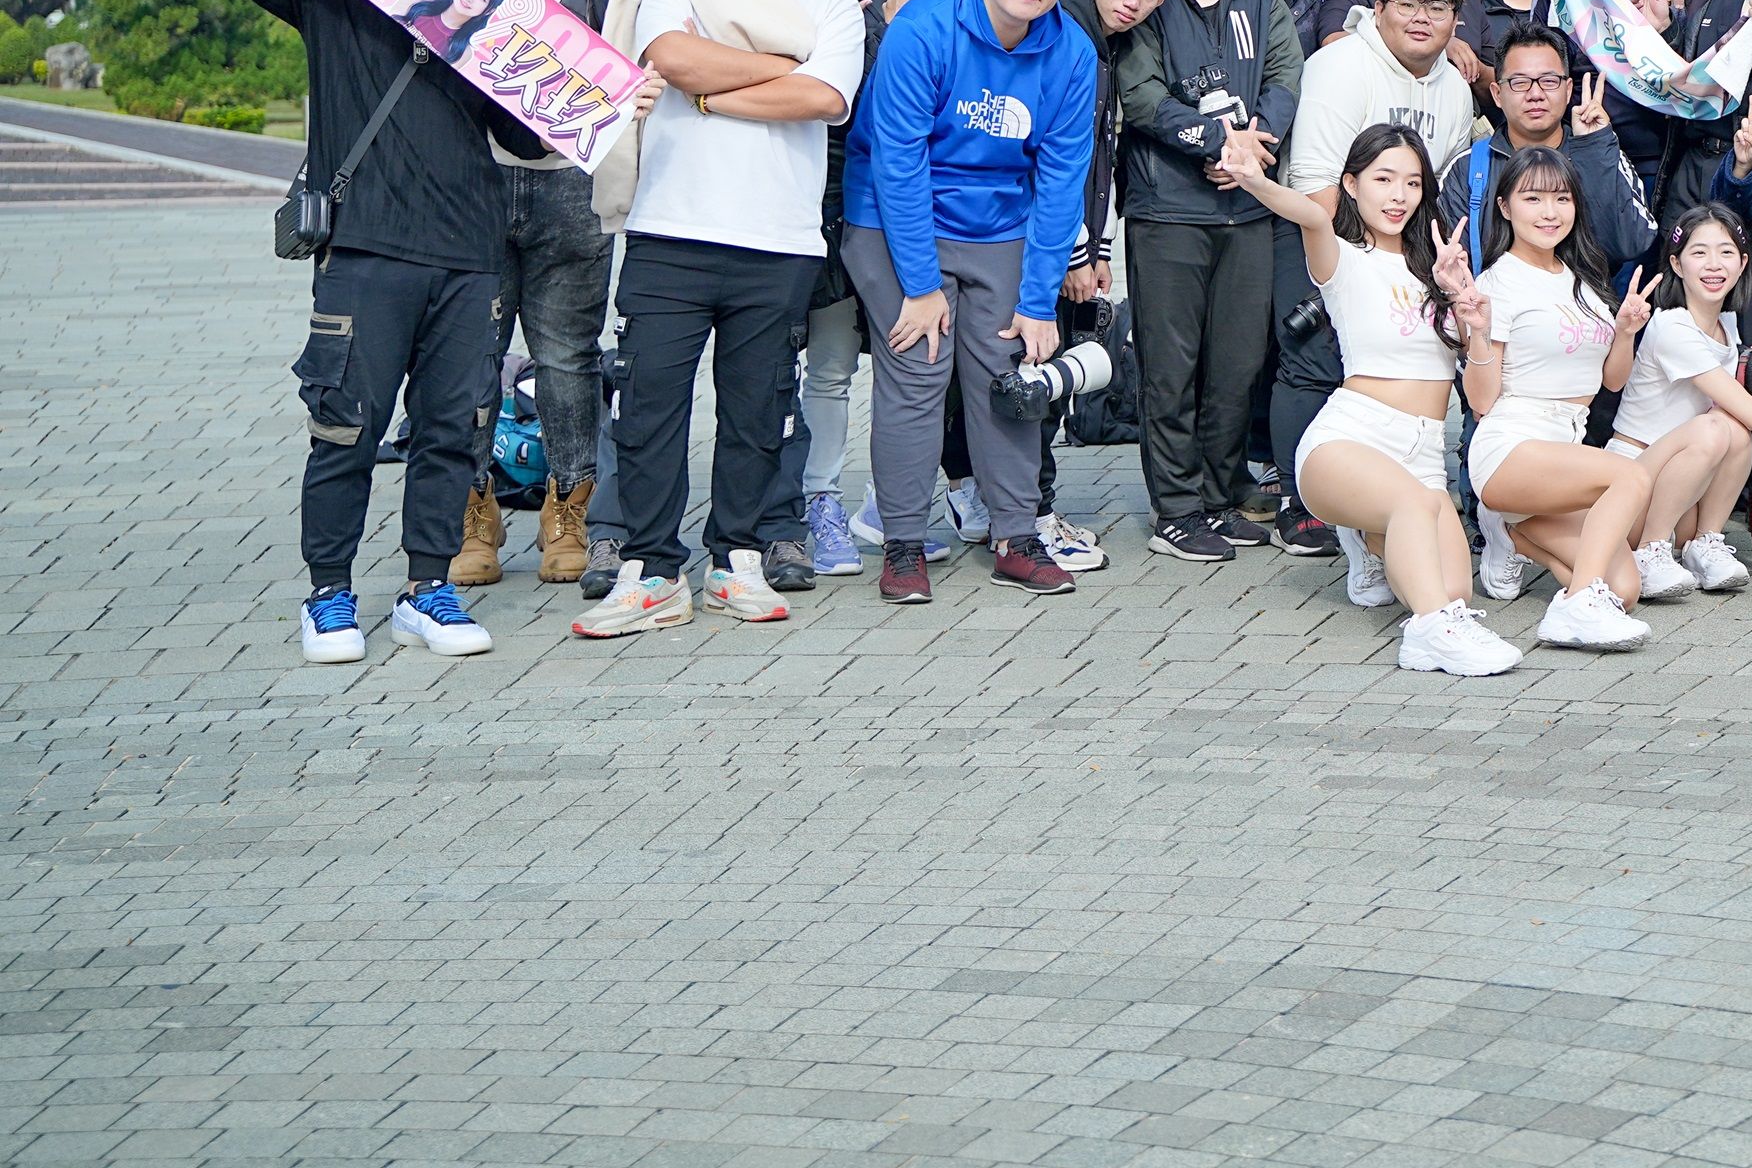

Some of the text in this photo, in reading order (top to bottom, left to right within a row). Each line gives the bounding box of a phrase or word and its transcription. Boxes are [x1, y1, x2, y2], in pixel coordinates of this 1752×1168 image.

[480, 23, 620, 162] 玖玖
[981, 88, 1006, 109] THE
[1627, 76, 1667, 102] TSG HAWKS
[956, 99, 1003, 123] NORTH
[968, 116, 1000, 137] FACE
[1178, 131, 1205, 147] adidas
